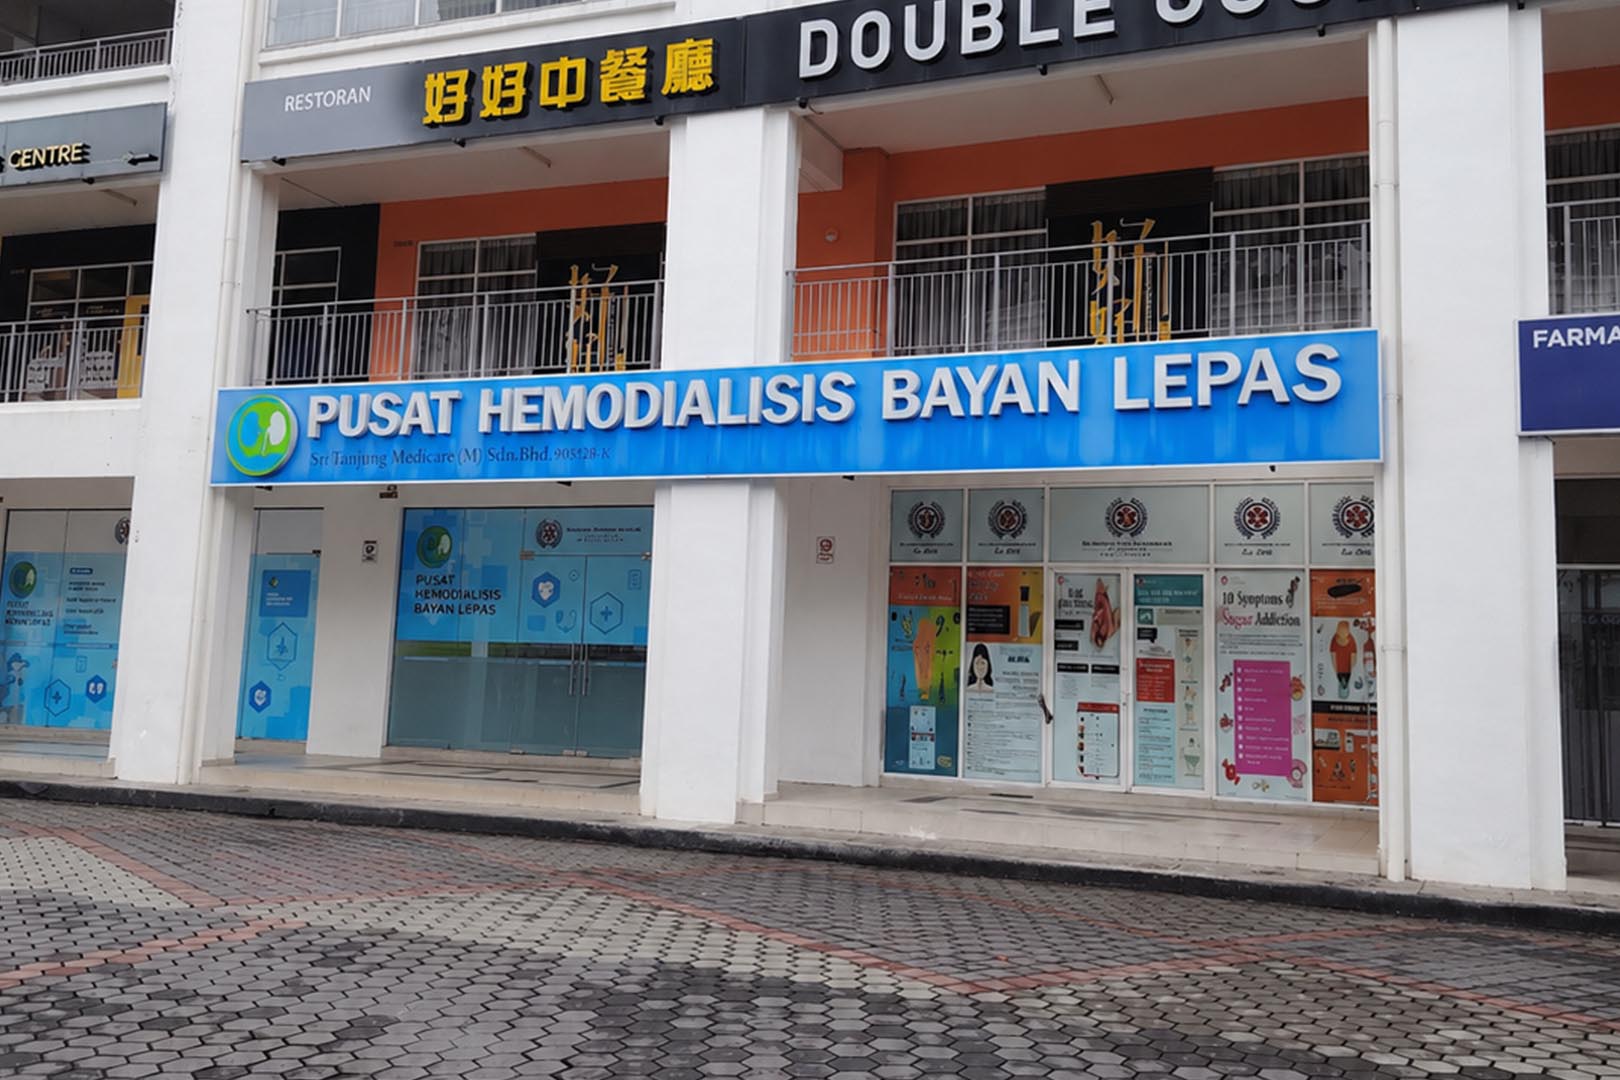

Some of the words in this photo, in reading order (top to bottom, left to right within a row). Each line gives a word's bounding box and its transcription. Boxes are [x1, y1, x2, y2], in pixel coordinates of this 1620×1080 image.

[799, 0, 1117, 78] DOUBLE
[421, 38, 714, 125] 好好中餐廳
[284, 86, 372, 113] RESTORAN
[8, 142, 84, 169] CENTRE
[306, 389, 462, 439] PUSAT
[478, 370, 857, 434] HEMODIALISIS
[881, 358, 1081, 421] BAYAN
[1113, 342, 1344, 411] LEPAS
[391, 448, 455, 466] Medicare
[457, 447, 481, 465] (M)
[416, 574, 455, 586] PUSAT
[414, 603, 454, 615] BAYAN
[458, 604, 496, 616] LEPAS
